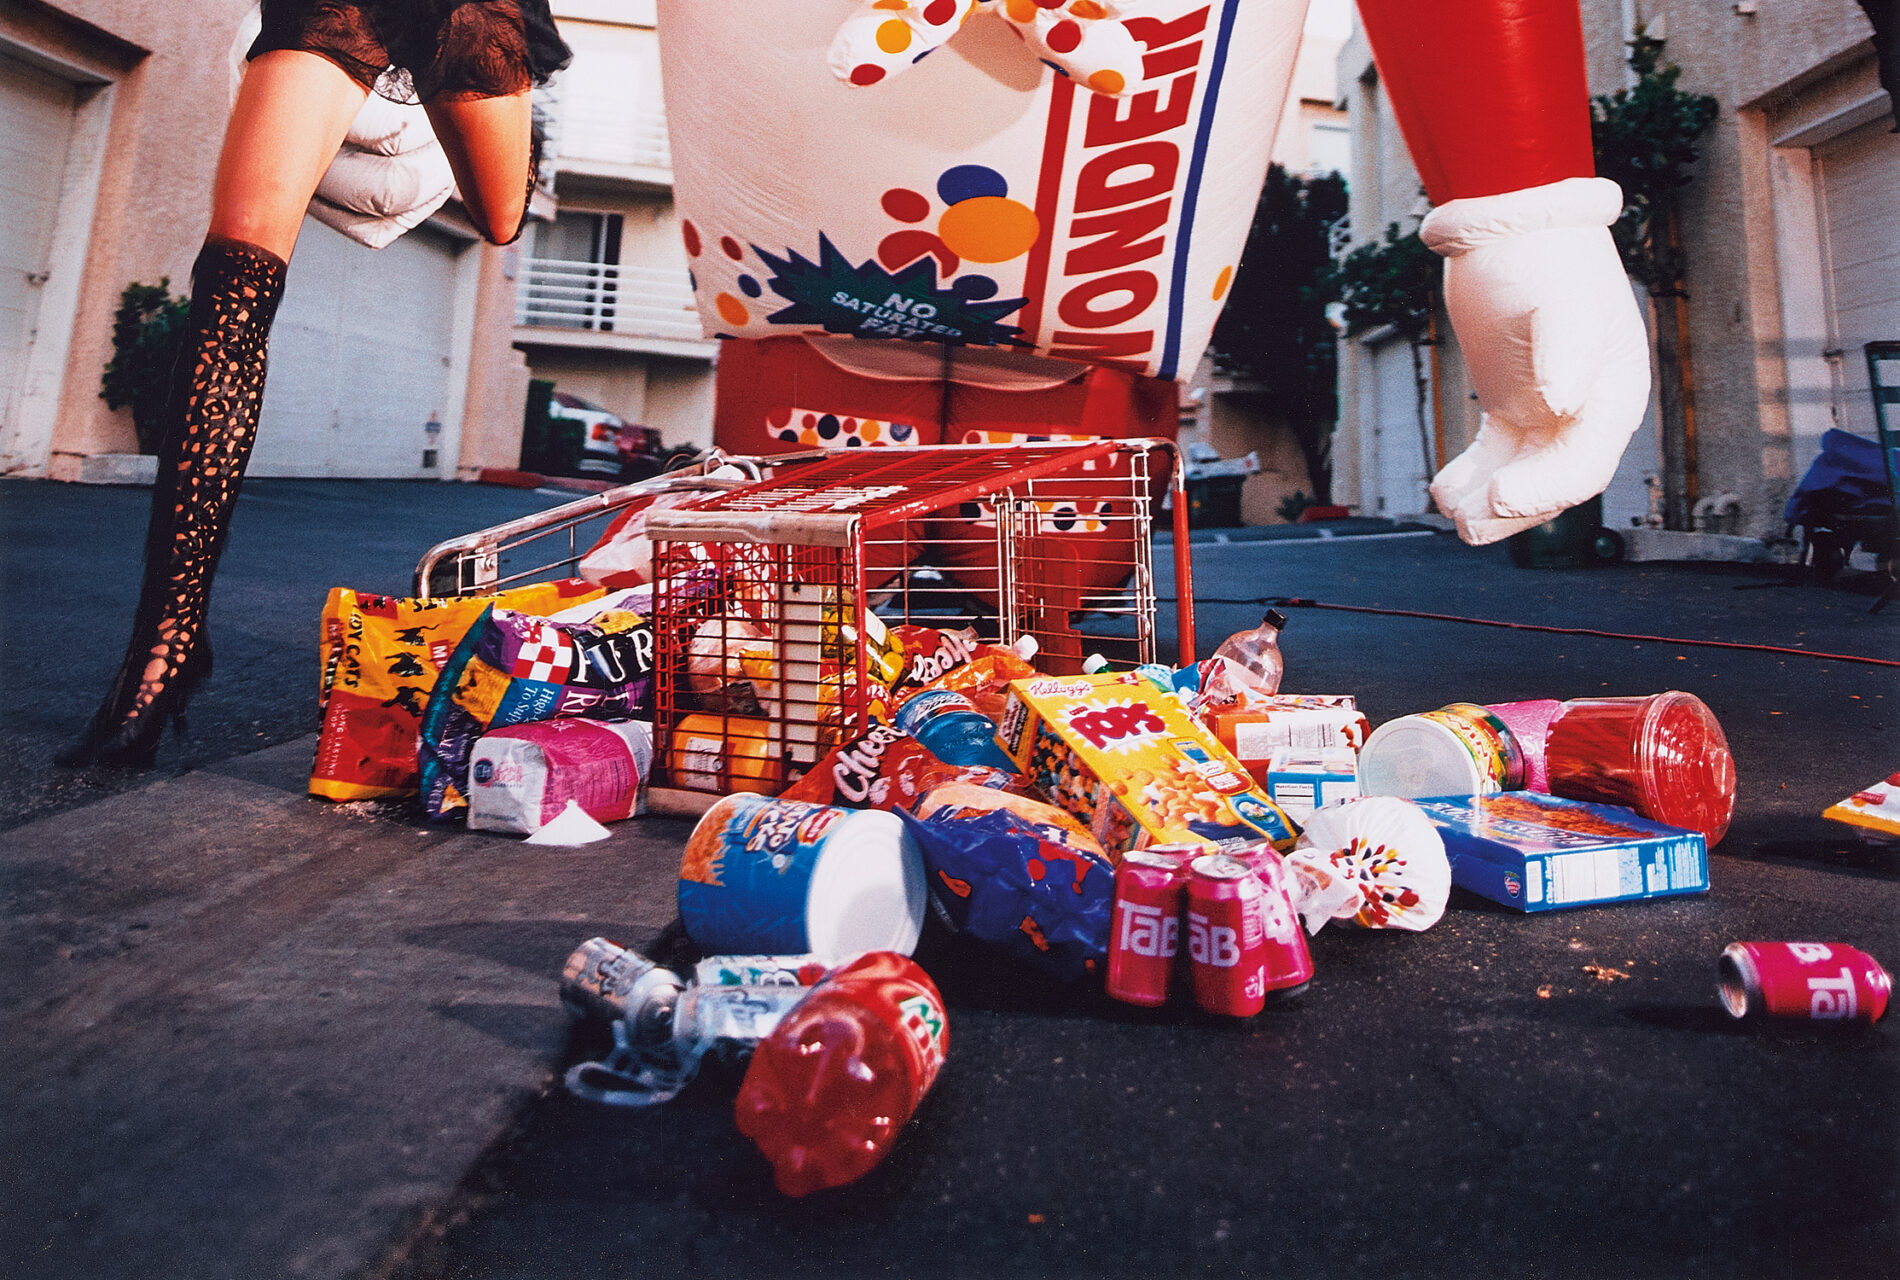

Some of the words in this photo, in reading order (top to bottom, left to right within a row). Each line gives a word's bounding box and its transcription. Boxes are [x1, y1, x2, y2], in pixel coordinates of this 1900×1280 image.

[832, 291, 963, 337] SATURATED
[883, 293, 937, 319] NO
[860, 317, 925, 338] FAT
[344, 644, 361, 688] CATS
[522, 686, 539, 701] To
[1069, 703, 1166, 751] POPS
